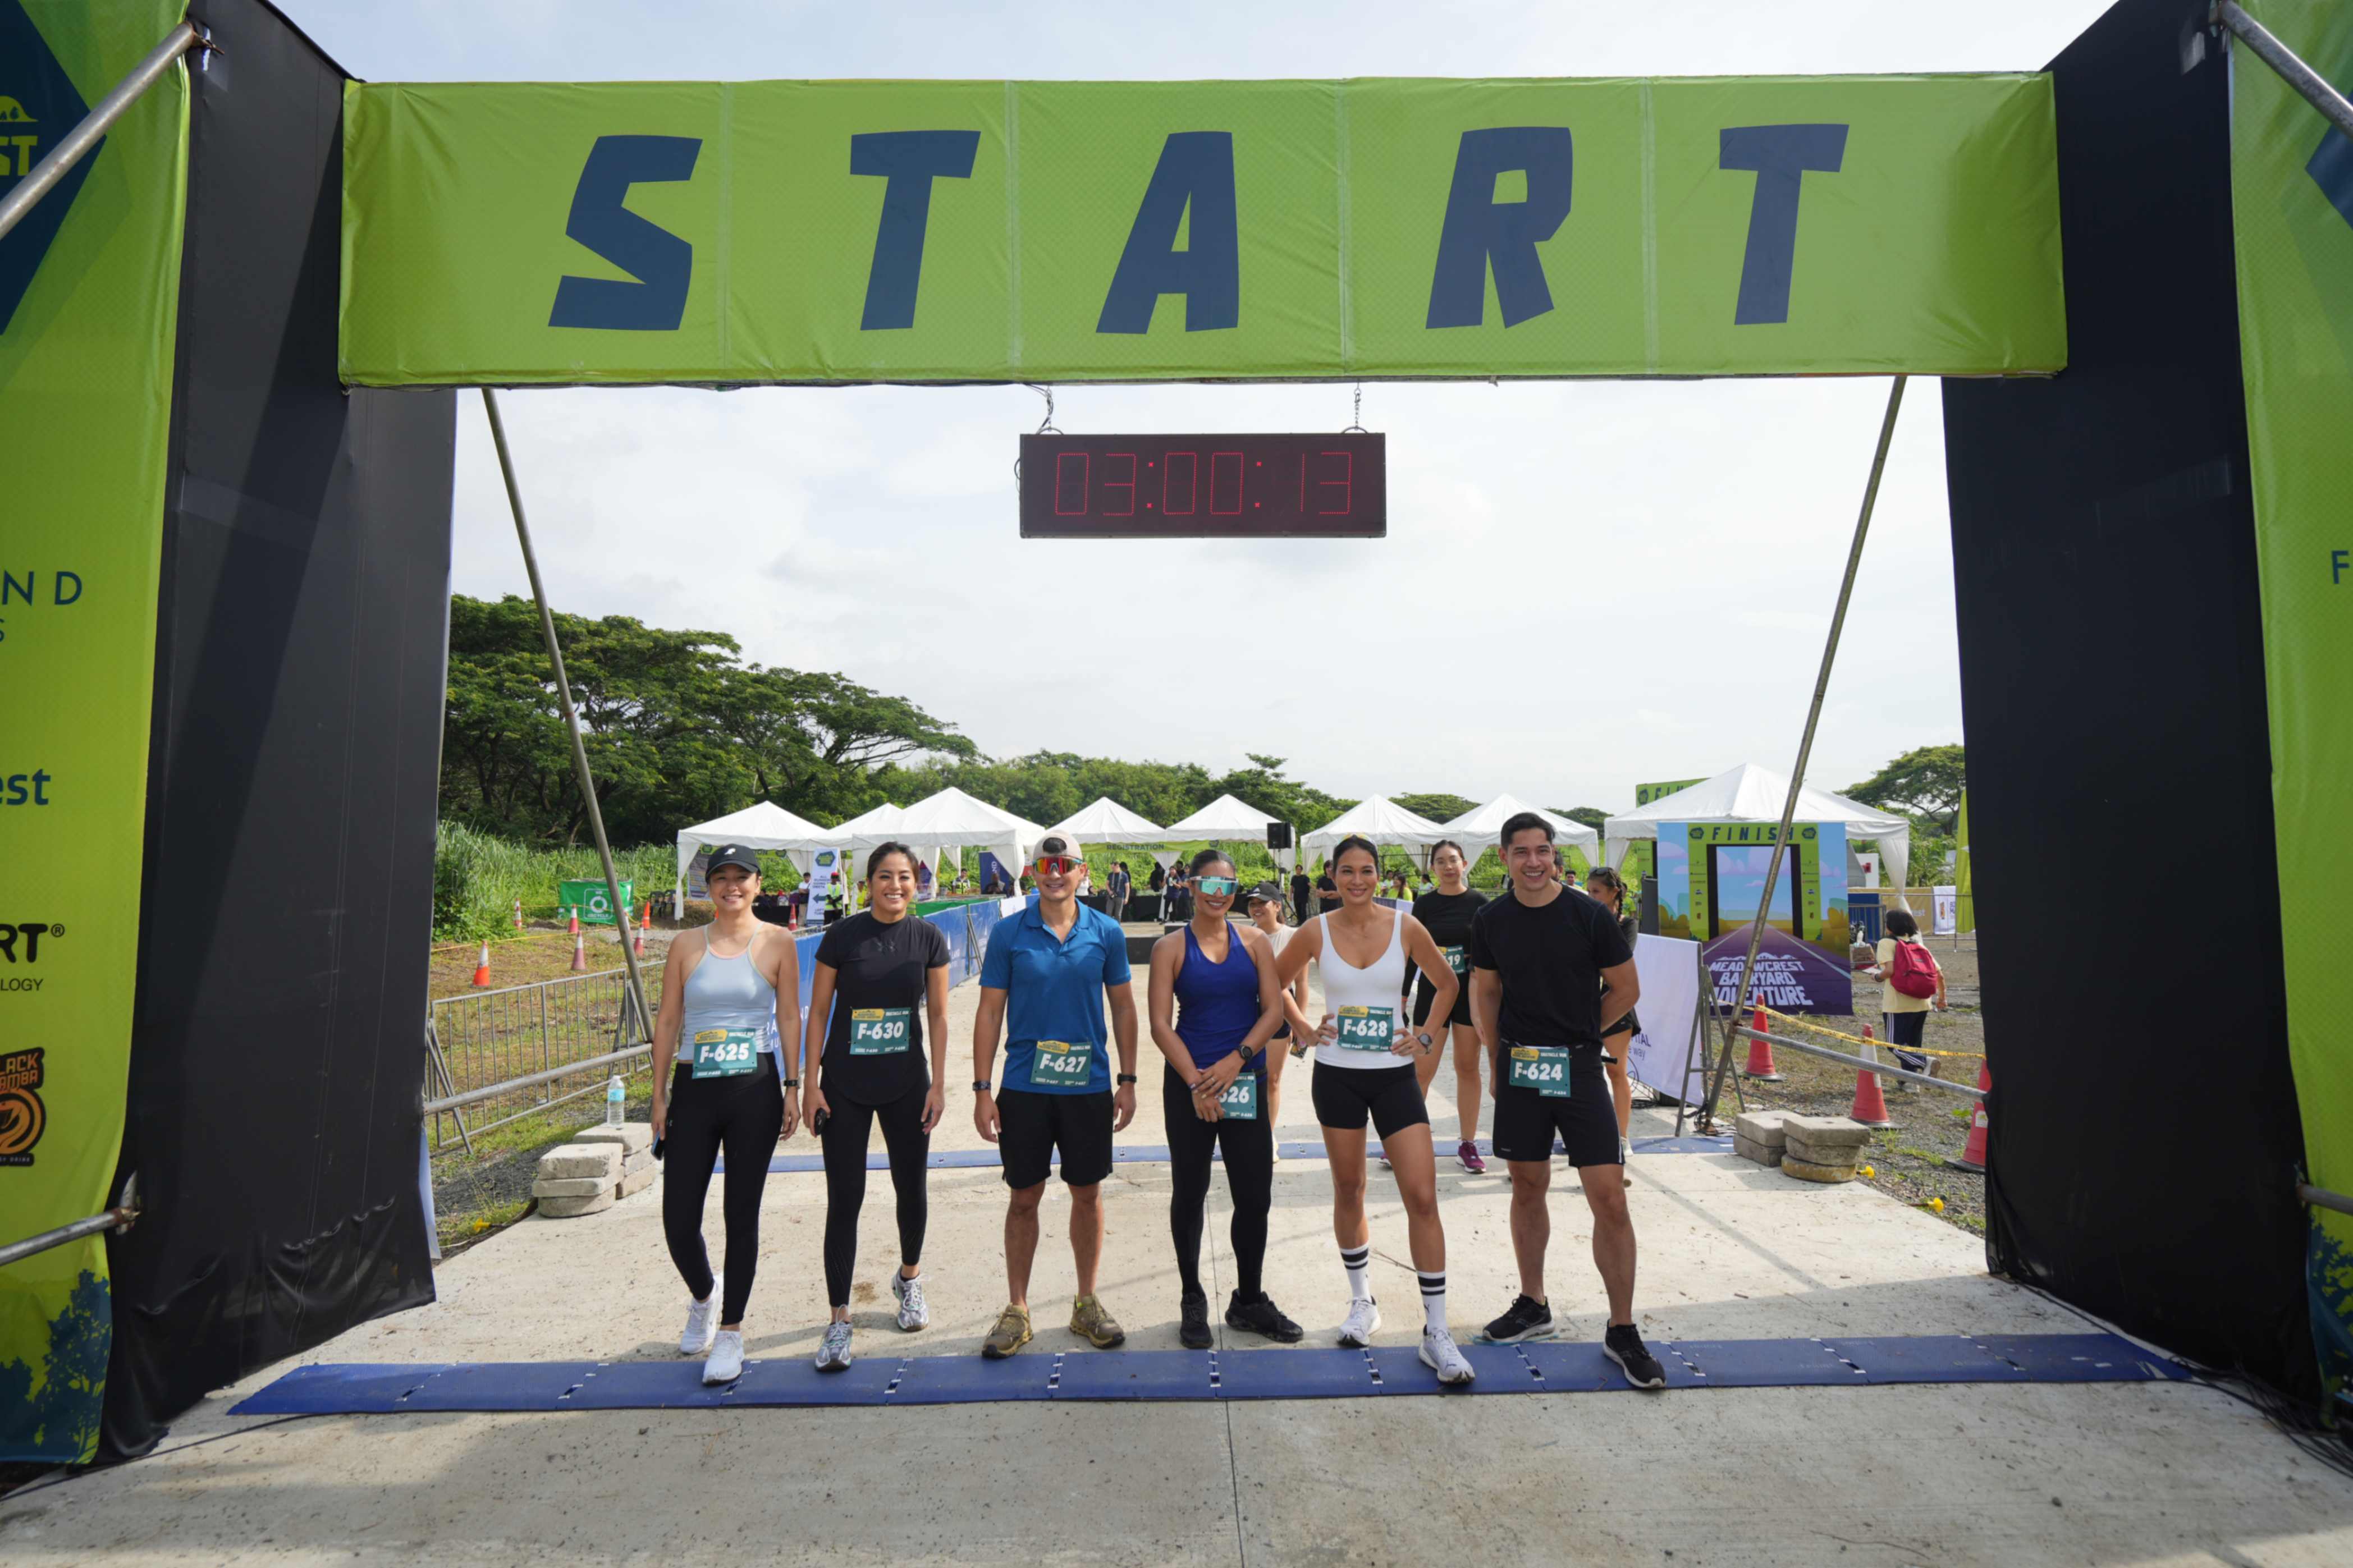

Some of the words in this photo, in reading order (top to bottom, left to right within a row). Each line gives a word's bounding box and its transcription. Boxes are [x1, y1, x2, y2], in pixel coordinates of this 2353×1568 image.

[550, 124, 1848, 333] START
[1055, 452, 1352, 516] 03:00:13
[0, 768, 51, 806] st
[1713, 827, 1794, 841] FINISH
[1710, 961, 1805, 971] MEADWCREST
[1, 978, 44, 991] LOGY
[1719, 972, 1796, 985] BAKYARD
[857, 1021, 904, 1040] F-630
[1343, 1019, 1388, 1037] F-628
[699, 1043, 749, 1063] F-625
[1040, 1053, 1087, 1073] F-627
[1515, 1062, 1563, 1081] F-624
